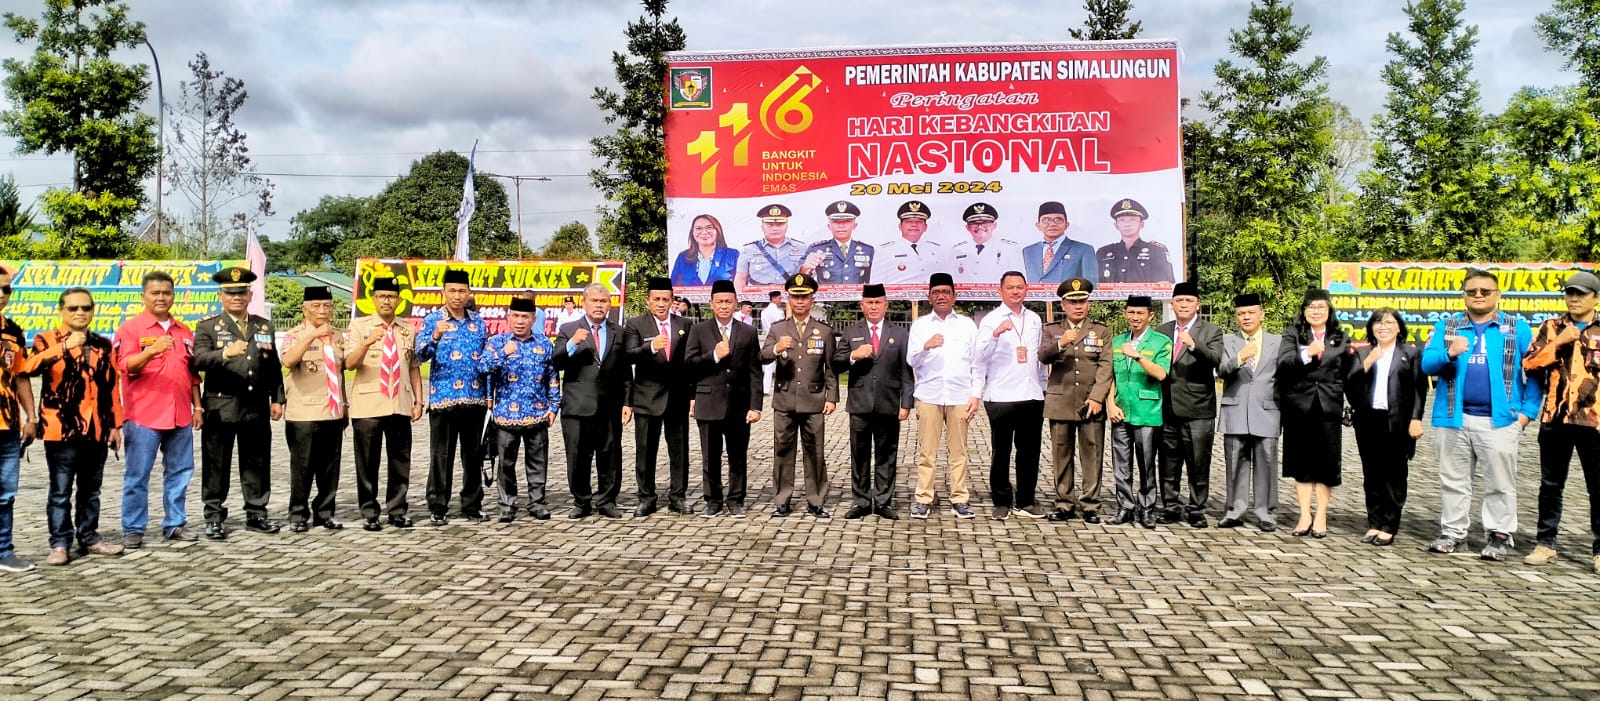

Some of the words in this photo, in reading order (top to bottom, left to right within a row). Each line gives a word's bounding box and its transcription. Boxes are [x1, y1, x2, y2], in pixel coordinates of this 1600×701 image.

[845, 63, 951, 85] PEMERINTAH
[955, 60, 1053, 82] KABUPATEN
[1057, 58, 1171, 80] SIMALUNGUN
[890, 90, 1040, 110] Peringatan
[847, 117, 912, 138] HARI
[918, 111, 1111, 135] KEBANGKITAN
[762, 150, 816, 160] BANGKIT
[848, 138, 1111, 178] NASIONAL
[762, 161, 803, 170] UNTUK
[762, 171, 828, 182] INDONESIA
[762, 184, 797, 193] EMAS
[850, 183, 882, 196] 20
[887, 182, 932, 194] Mei
[938, 180, 1002, 194] 2024
[20, 266, 113, 286] SELAMAT
[501, 266, 574, 289] SUKSES
[1362, 269, 1467, 291] SELAMAT
[1331, 296, 1357, 309] CARA
